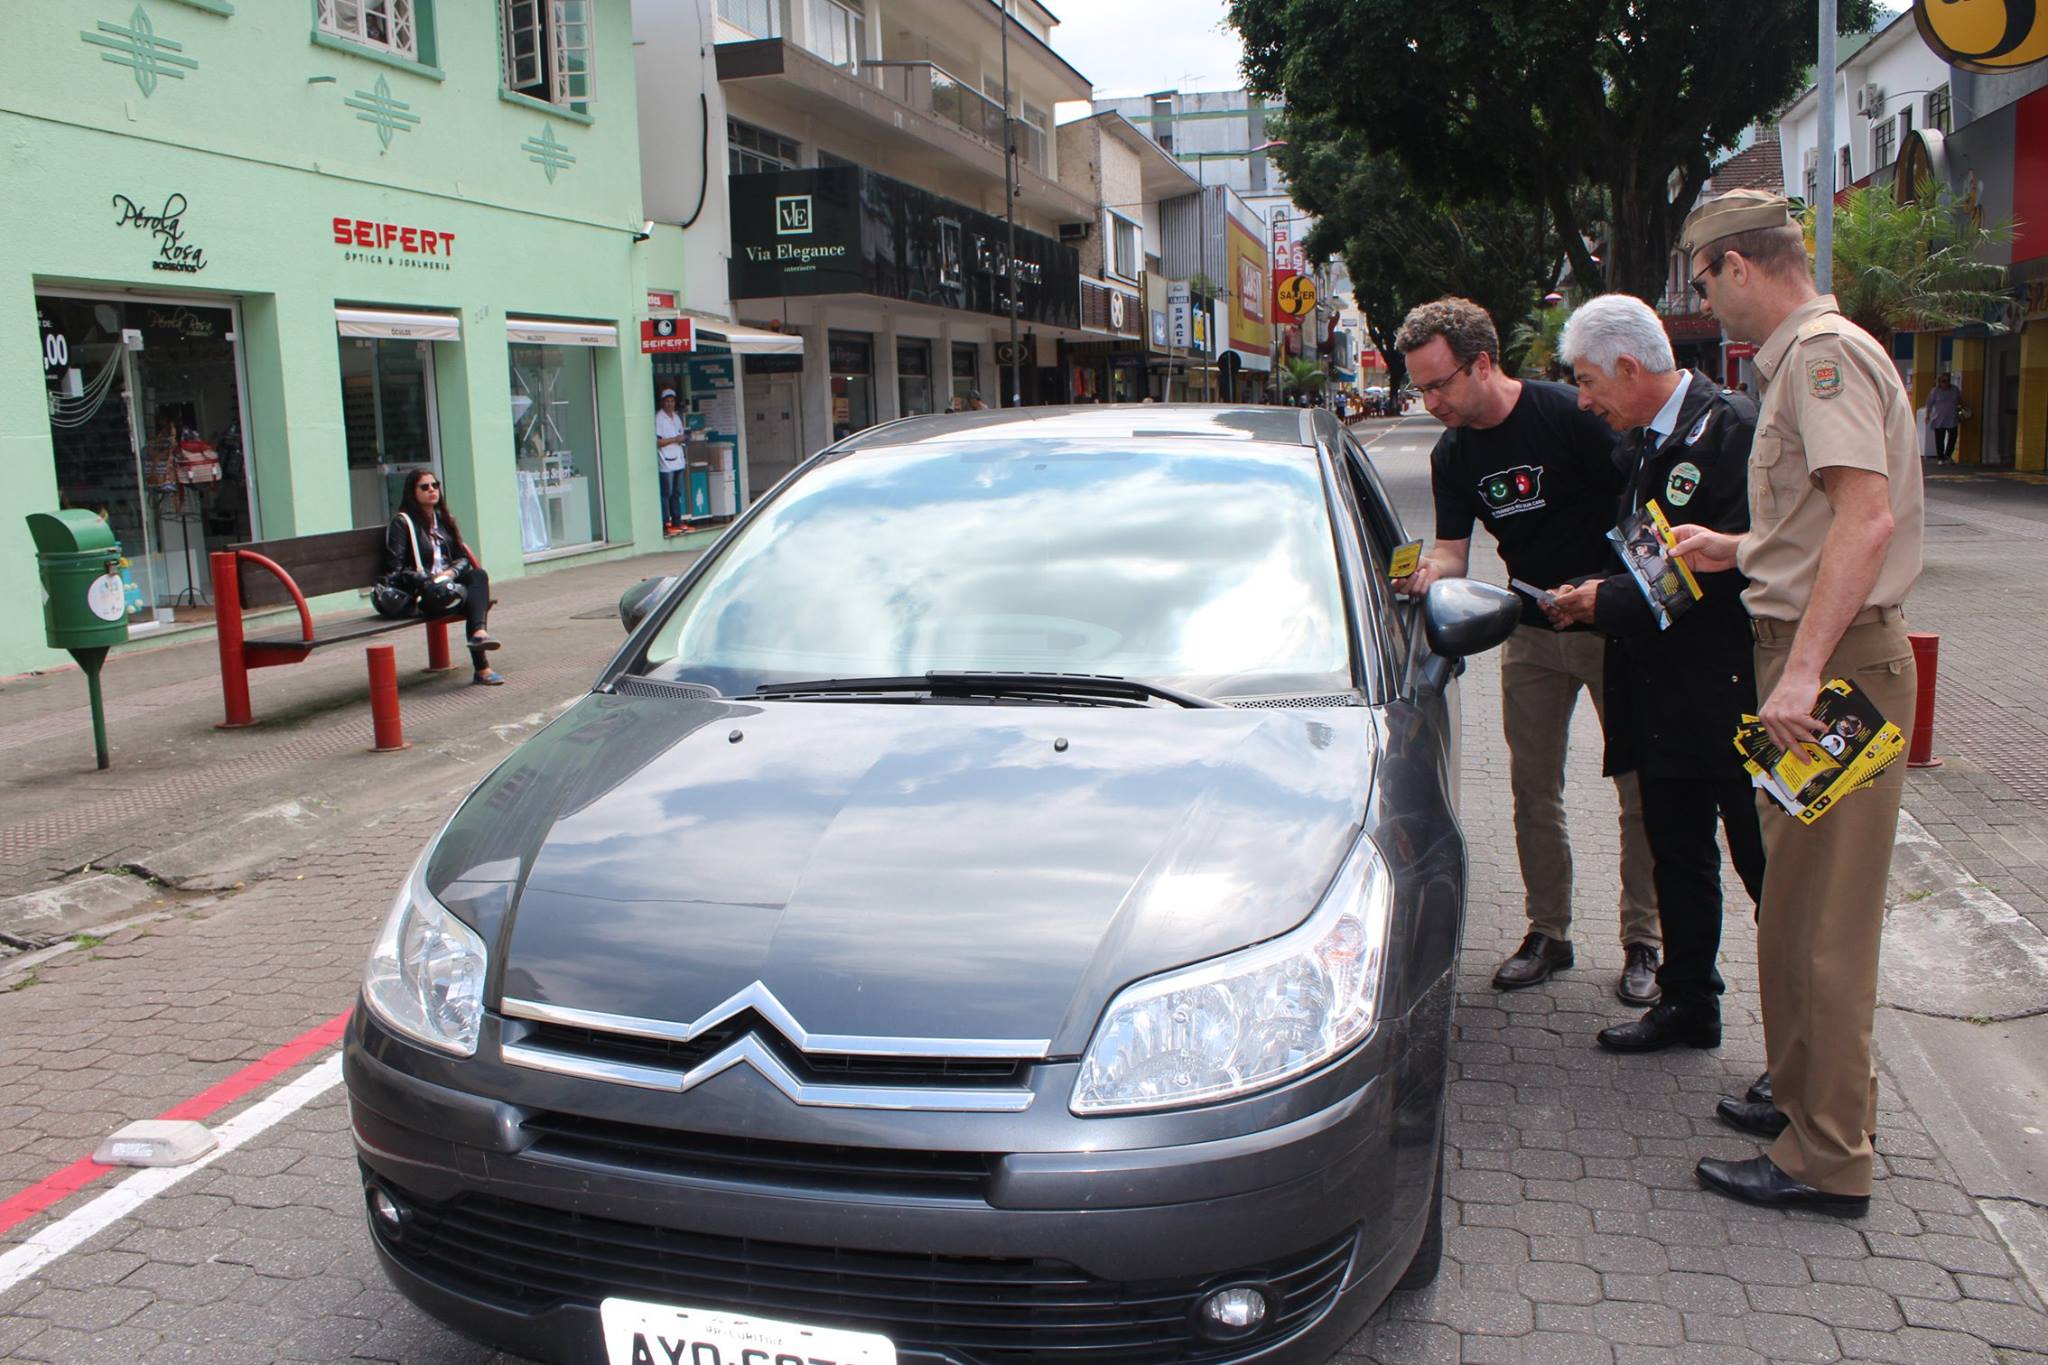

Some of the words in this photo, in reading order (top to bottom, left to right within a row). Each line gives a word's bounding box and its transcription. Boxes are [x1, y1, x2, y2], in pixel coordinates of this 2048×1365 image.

[113, 193, 187, 240] Pérola
[153, 229, 207, 270] Rosa
[333, 217, 455, 257] SEIFERT
[745, 246, 771, 261] Via
[776, 244, 846, 262] Elegance
[1280, 290, 1315, 300] SAER
[642, 339, 690, 349] SEIFERT
[1175, 307, 1184, 345] SPACE
